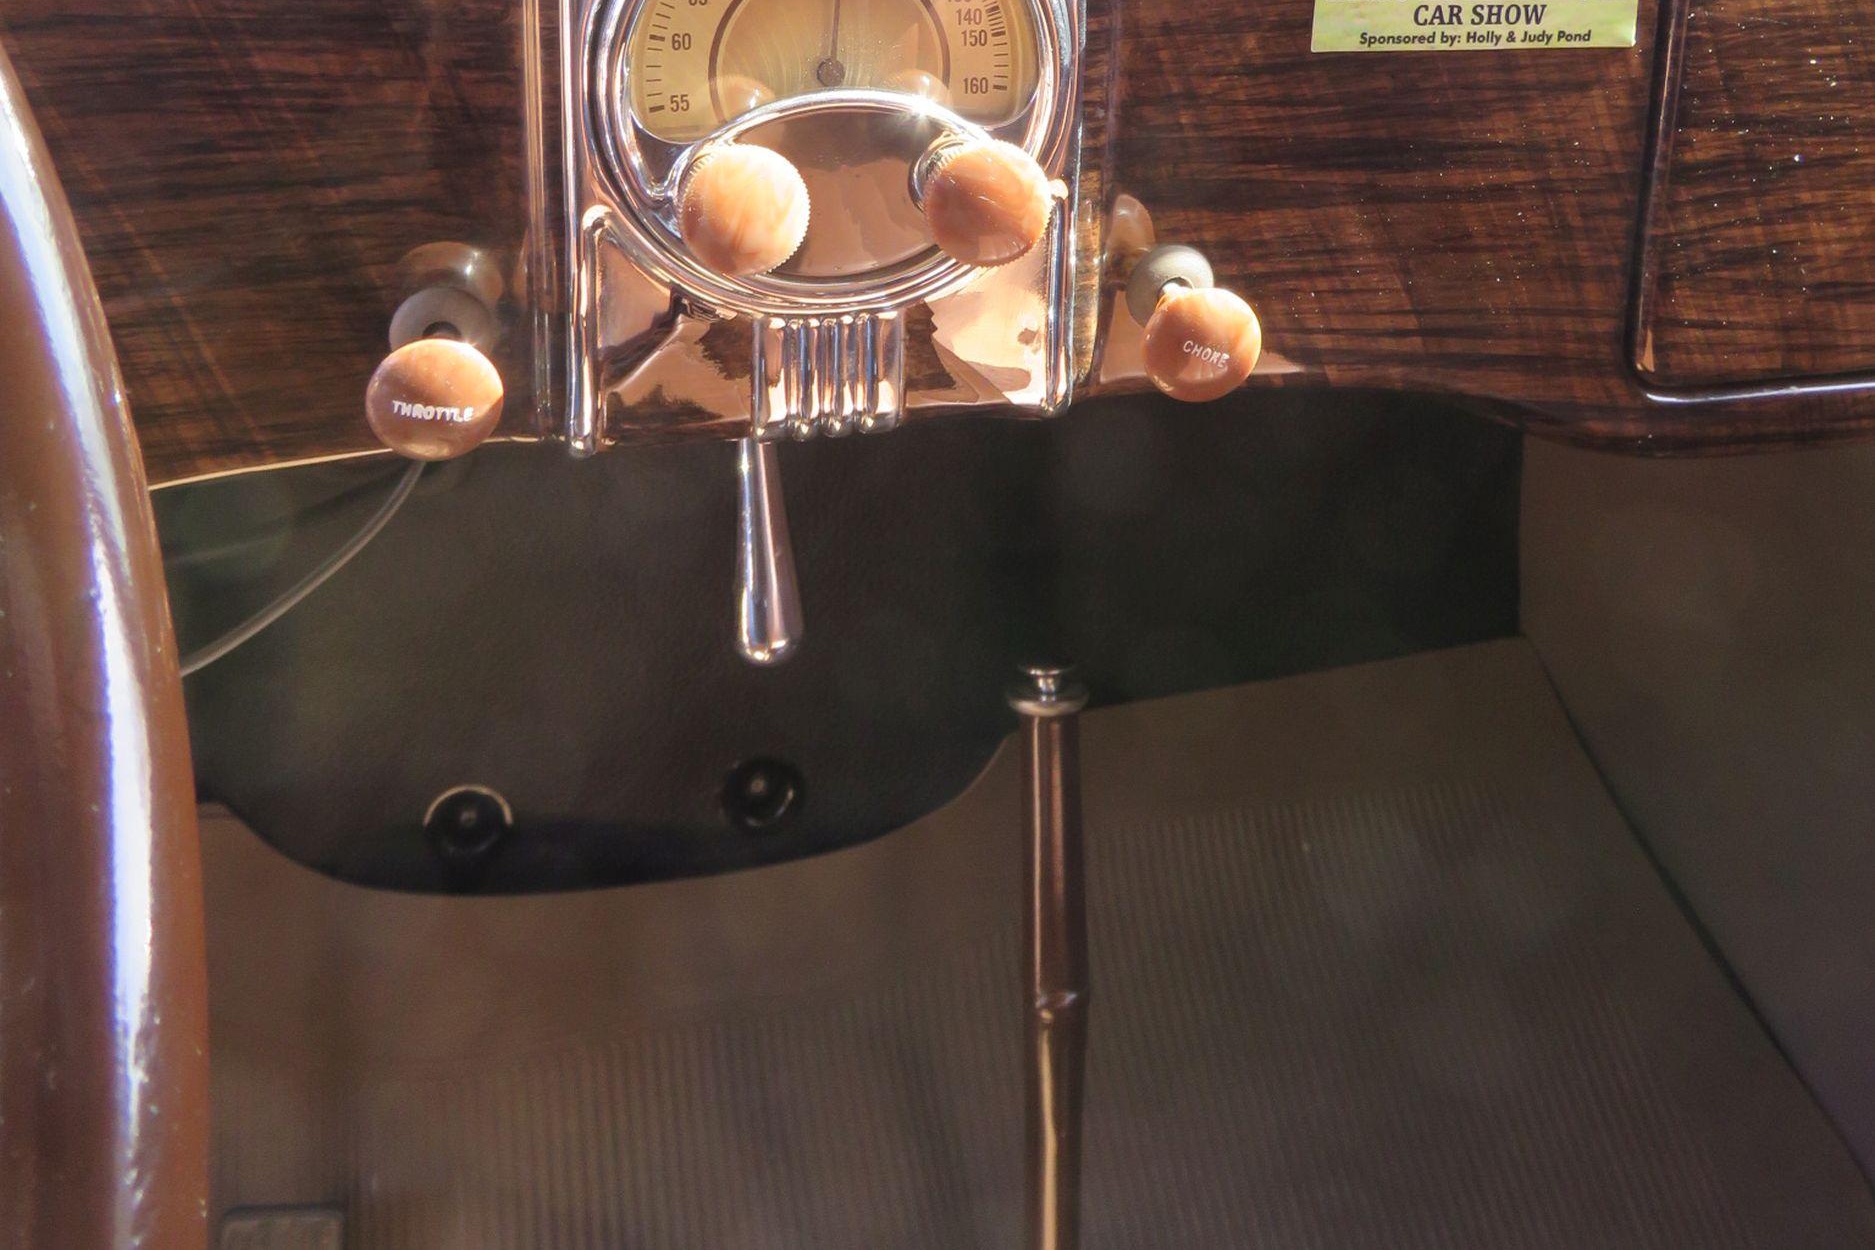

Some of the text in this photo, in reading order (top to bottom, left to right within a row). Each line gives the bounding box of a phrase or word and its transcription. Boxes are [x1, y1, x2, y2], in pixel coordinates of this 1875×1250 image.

[956, 7, 982, 26] 140
[1413, 4, 1548, 26] CAR SHOW
[671, 32, 692, 51] 60
[961, 29, 987, 47] 150
[1359, 29, 1591, 47] Sponsored by: Holly & Judy Pond
[963, 76, 988, 94] 160
[670, 94, 690, 113] 55
[392, 400, 474, 422] THROTTLE
